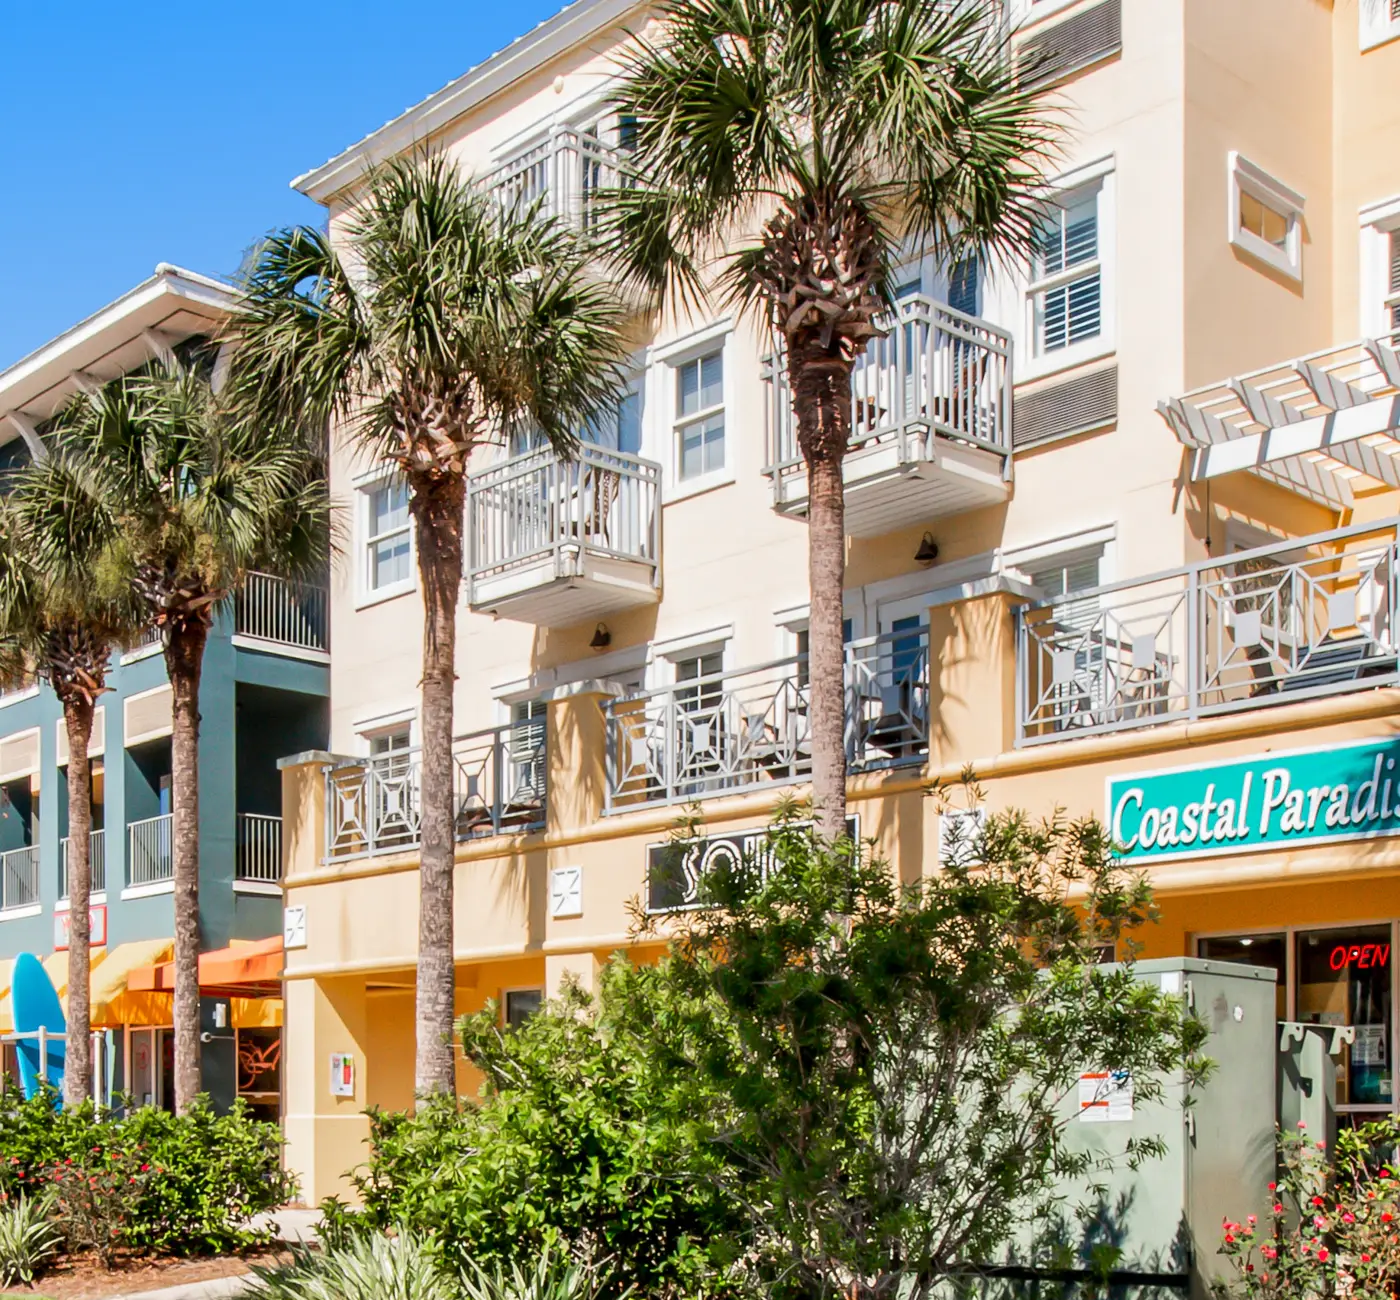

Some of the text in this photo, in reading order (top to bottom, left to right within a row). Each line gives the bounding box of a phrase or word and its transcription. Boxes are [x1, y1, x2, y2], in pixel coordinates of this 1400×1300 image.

[1112, 753, 1400, 850] Coastal Paradi
[1329, 944, 1390, 971] OPEN
